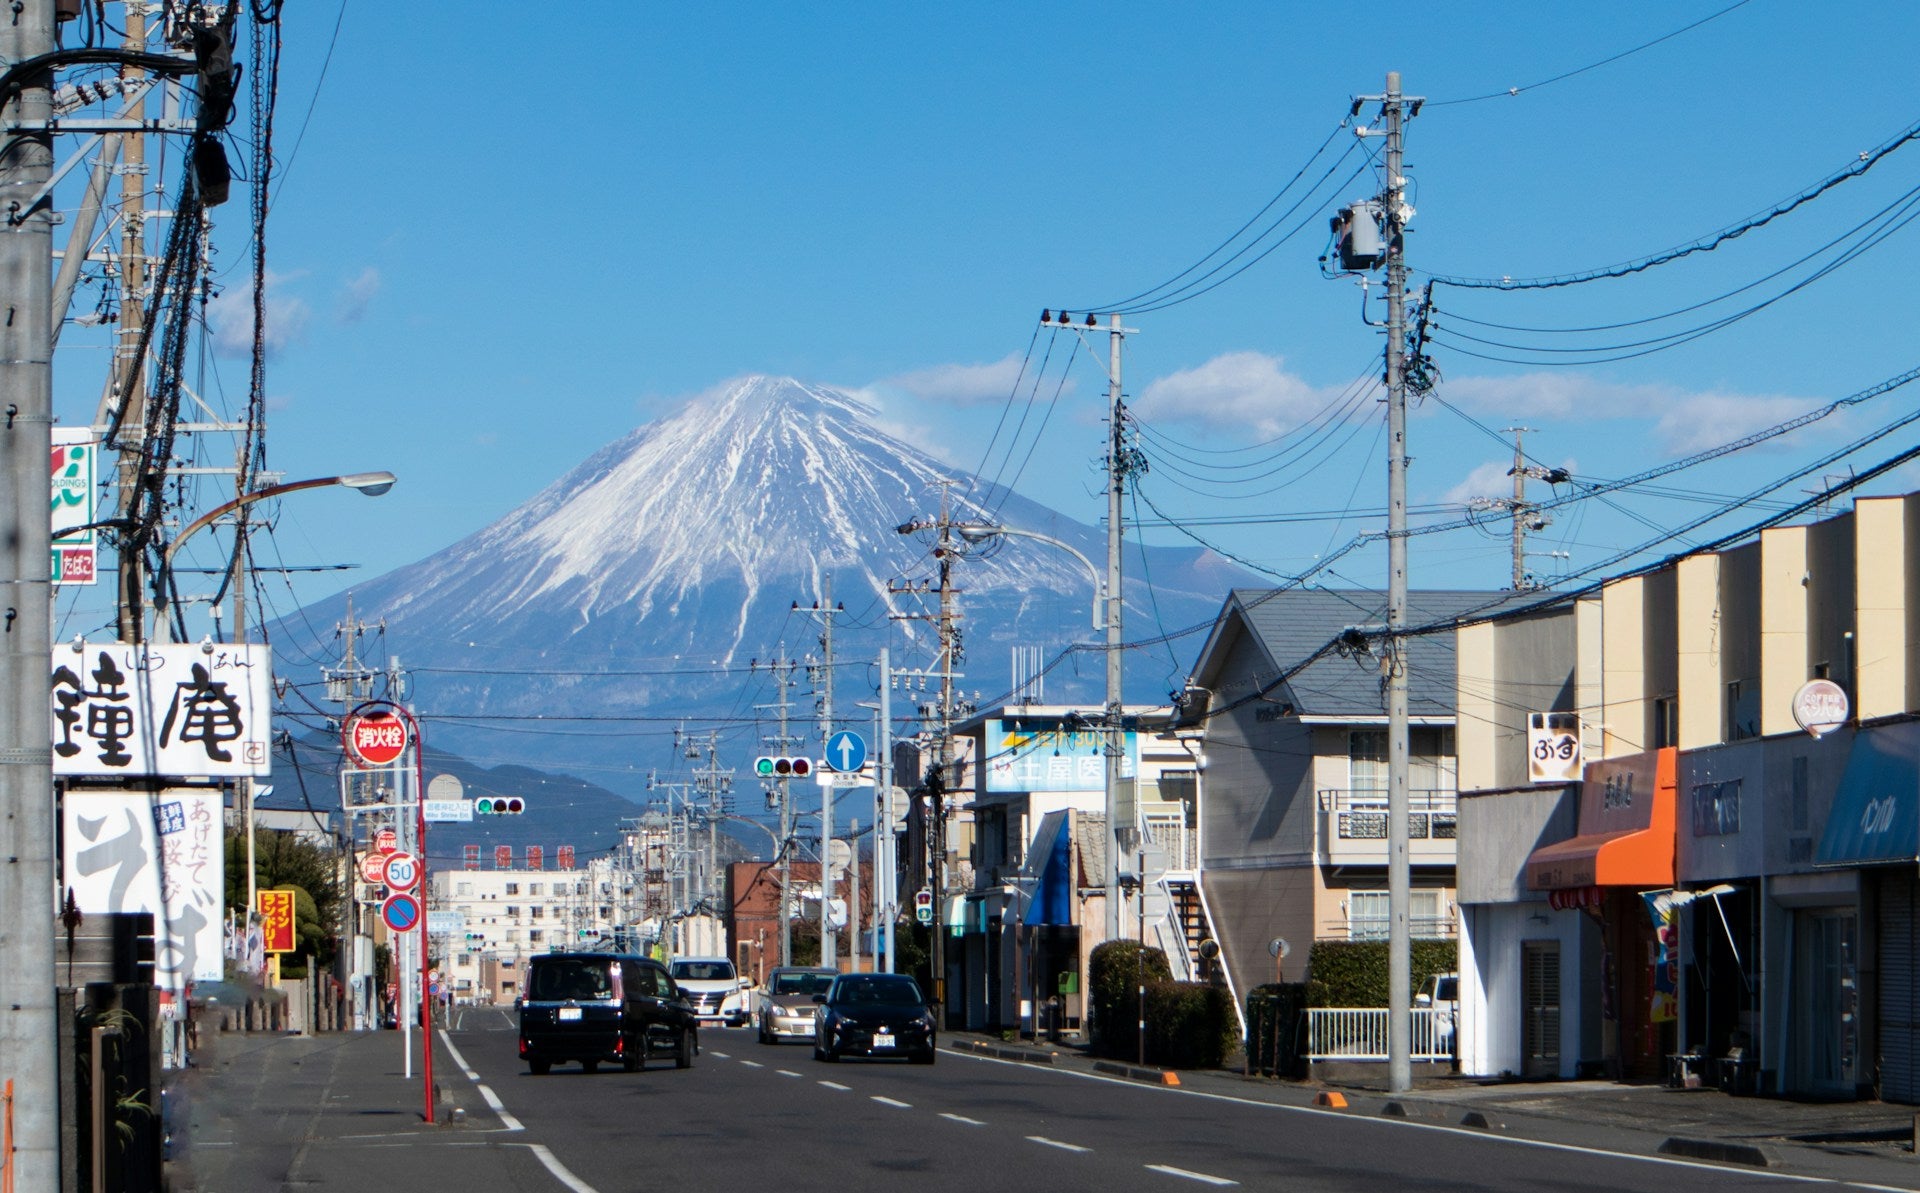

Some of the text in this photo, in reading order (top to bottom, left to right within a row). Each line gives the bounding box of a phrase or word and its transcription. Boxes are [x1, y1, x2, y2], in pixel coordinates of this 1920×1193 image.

[63, 555, 92, 575] たばこ
[213, 652, 255, 670] あん
[52, 651, 244, 766] 鐘庵
[1804, 694, 1840, 703] COFFEE
[357, 726, 402, 748] 消火栓
[186, 799, 212, 885] あげたて
[390, 863, 411, 880] 50
[263, 894, 276, 950] ランドリー
[277, 894, 290, 928] コイン
